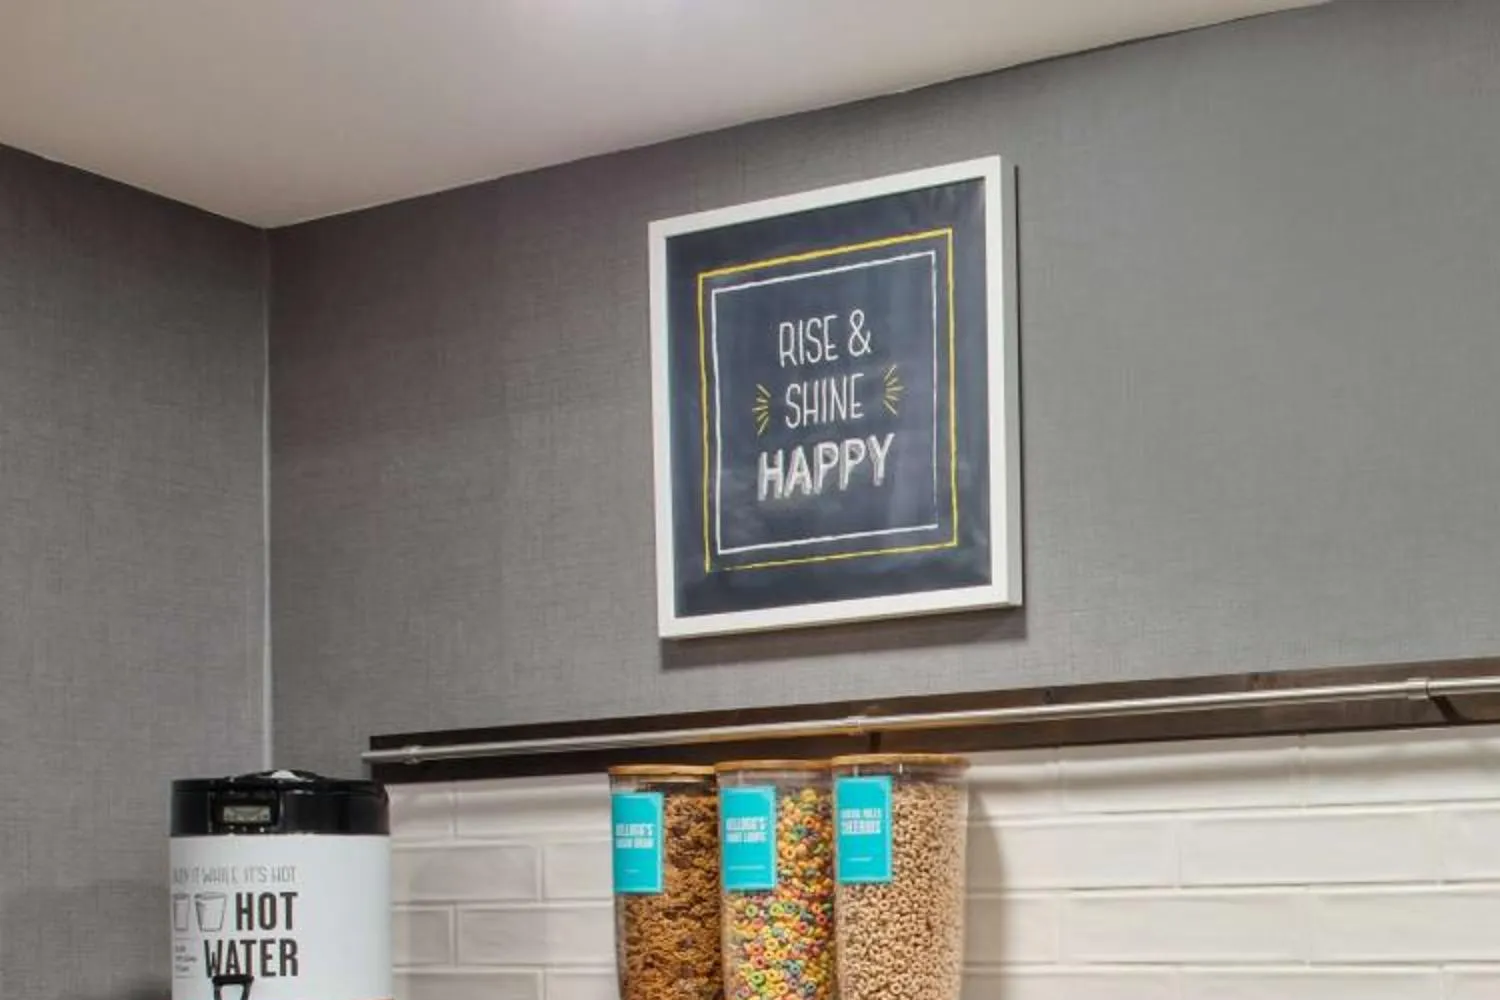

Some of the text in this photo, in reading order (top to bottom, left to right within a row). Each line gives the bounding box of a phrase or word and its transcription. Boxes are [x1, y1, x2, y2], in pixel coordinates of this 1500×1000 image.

[779, 308, 872, 368] RISE &
[785, 372, 864, 429] SHINE
[757, 432, 895, 501] HAPPY
[271, 865, 296, 882] HOT
[235, 892, 298, 931] HOT
[204, 938, 298, 978] WATER
